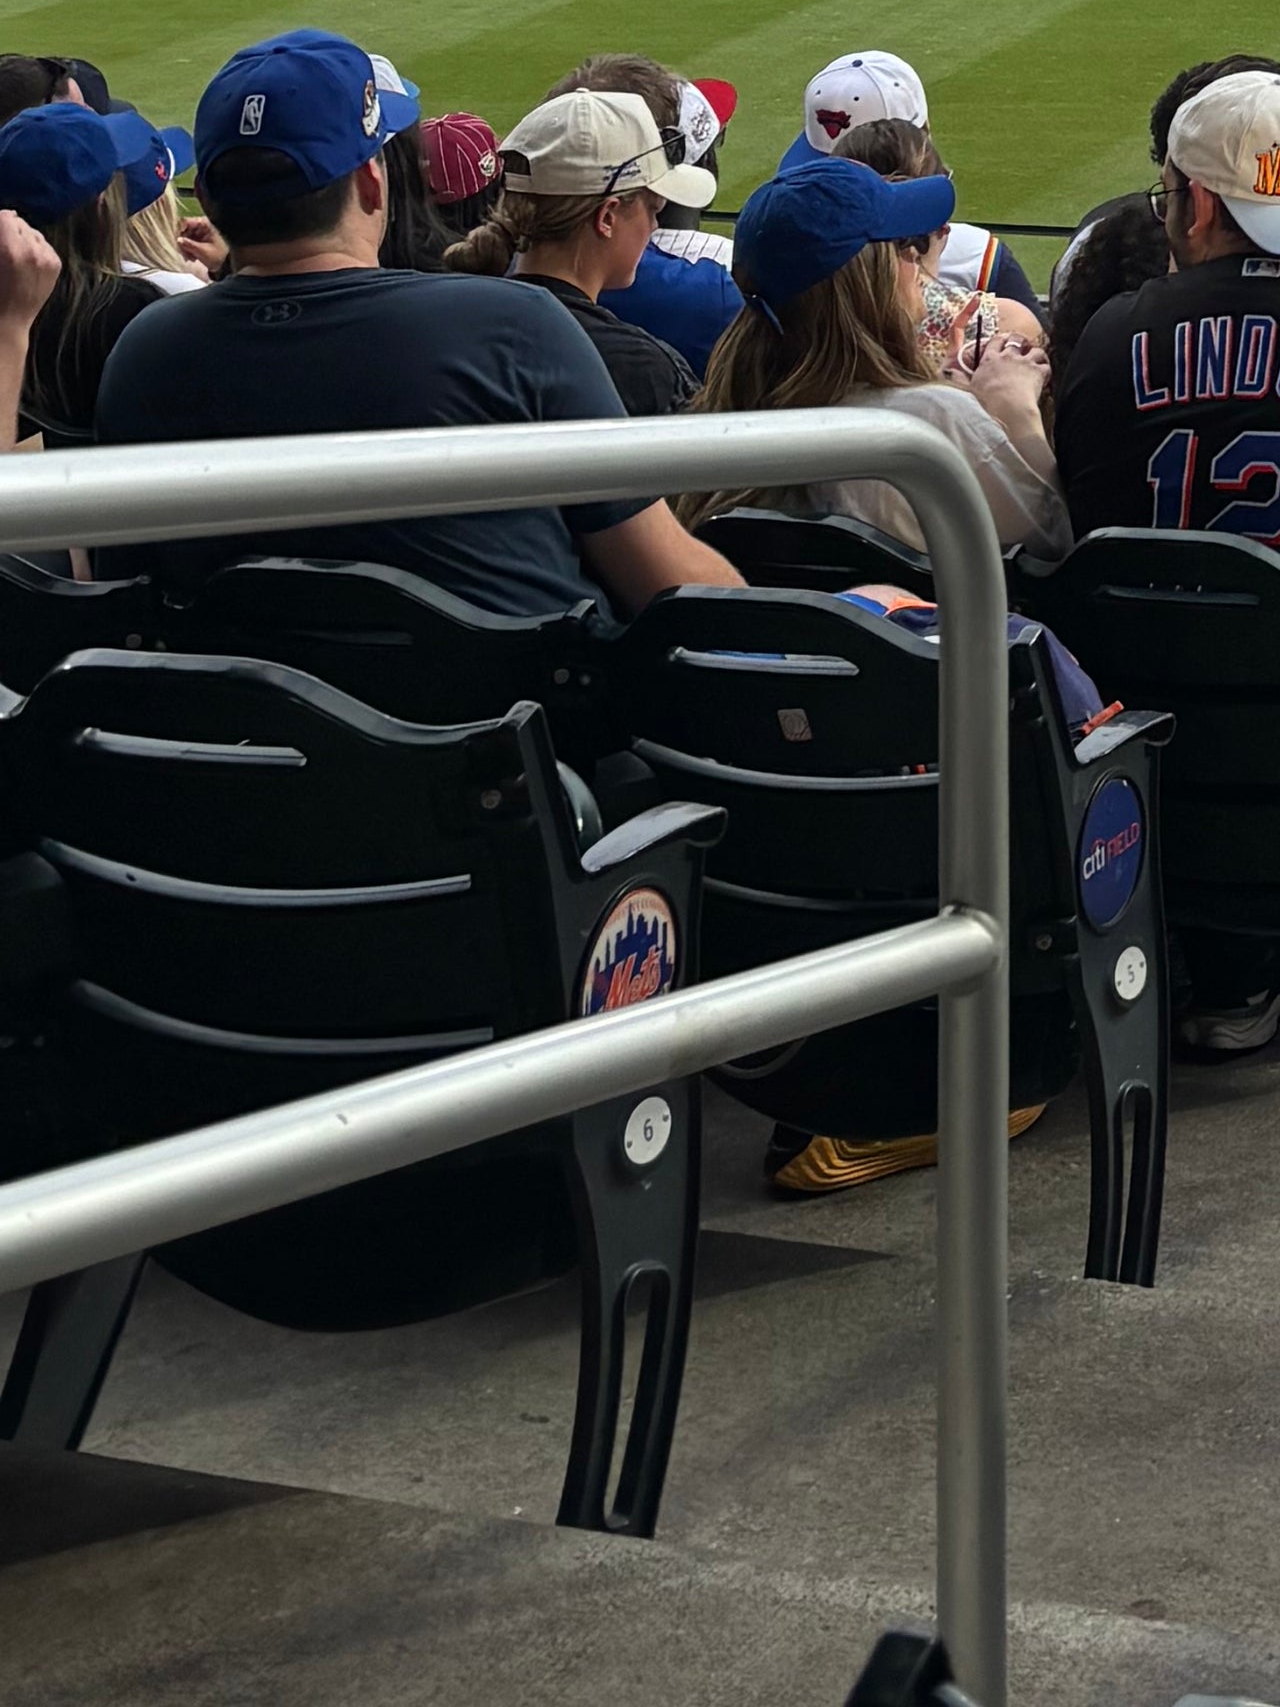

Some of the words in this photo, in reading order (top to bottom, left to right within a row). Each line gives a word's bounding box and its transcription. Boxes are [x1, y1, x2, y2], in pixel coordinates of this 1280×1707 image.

[1082, 840, 1106, 880] citi
[1106, 822, 1140, 861] FIELD
[604, 944, 663, 1011] Mets
[1126, 964, 1136, 984] 5
[643, 1118, 654, 1142] 6
